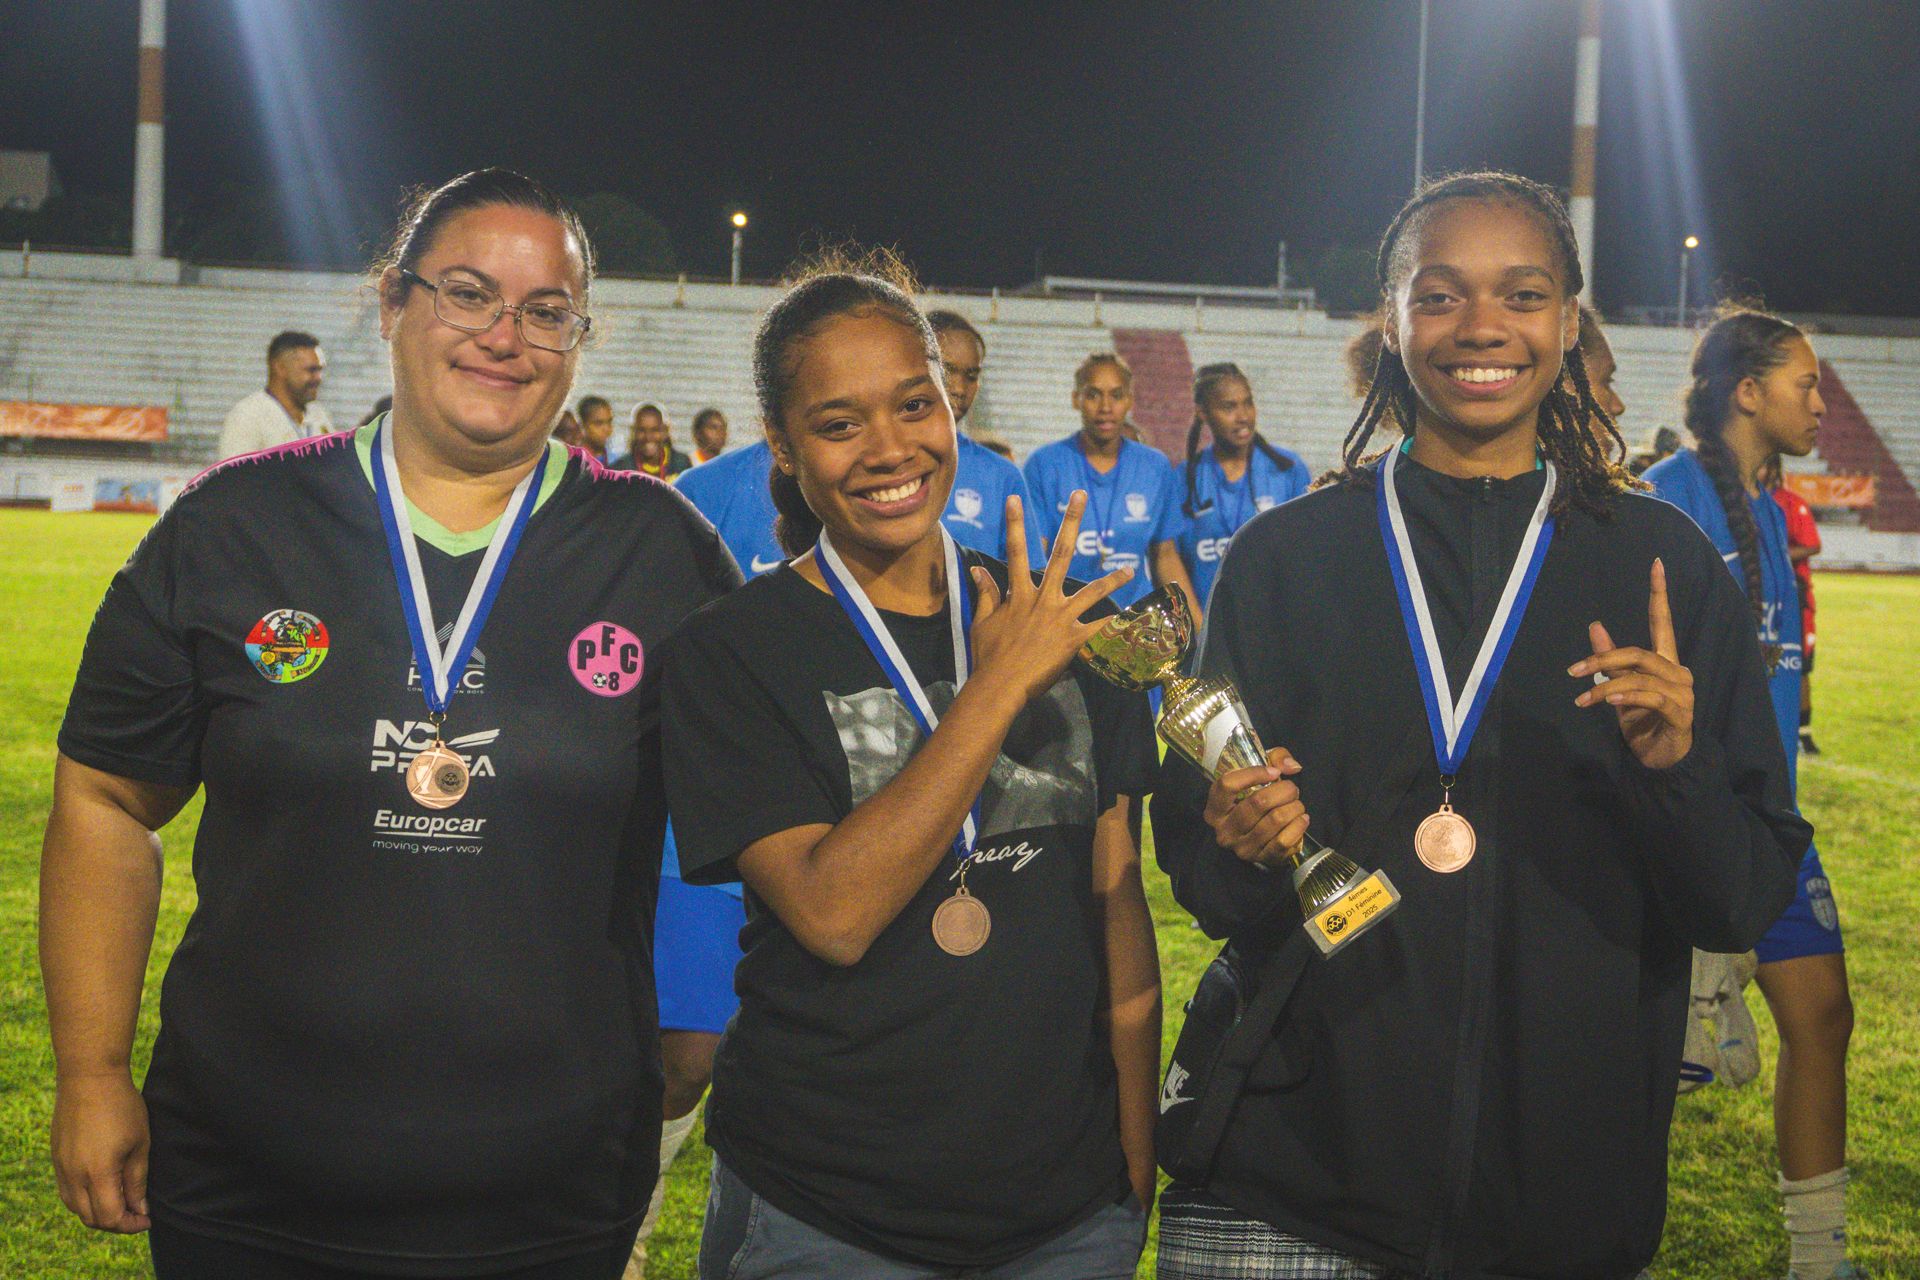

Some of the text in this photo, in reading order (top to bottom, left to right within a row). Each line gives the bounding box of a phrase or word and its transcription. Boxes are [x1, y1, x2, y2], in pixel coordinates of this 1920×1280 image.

[576, 625, 639, 674] PFC
[373, 809, 487, 838] Europcar
[372, 839, 484, 856] moving your way
[1345, 908, 1356, 918] D1
[1362, 904, 1378, 918] 2025
